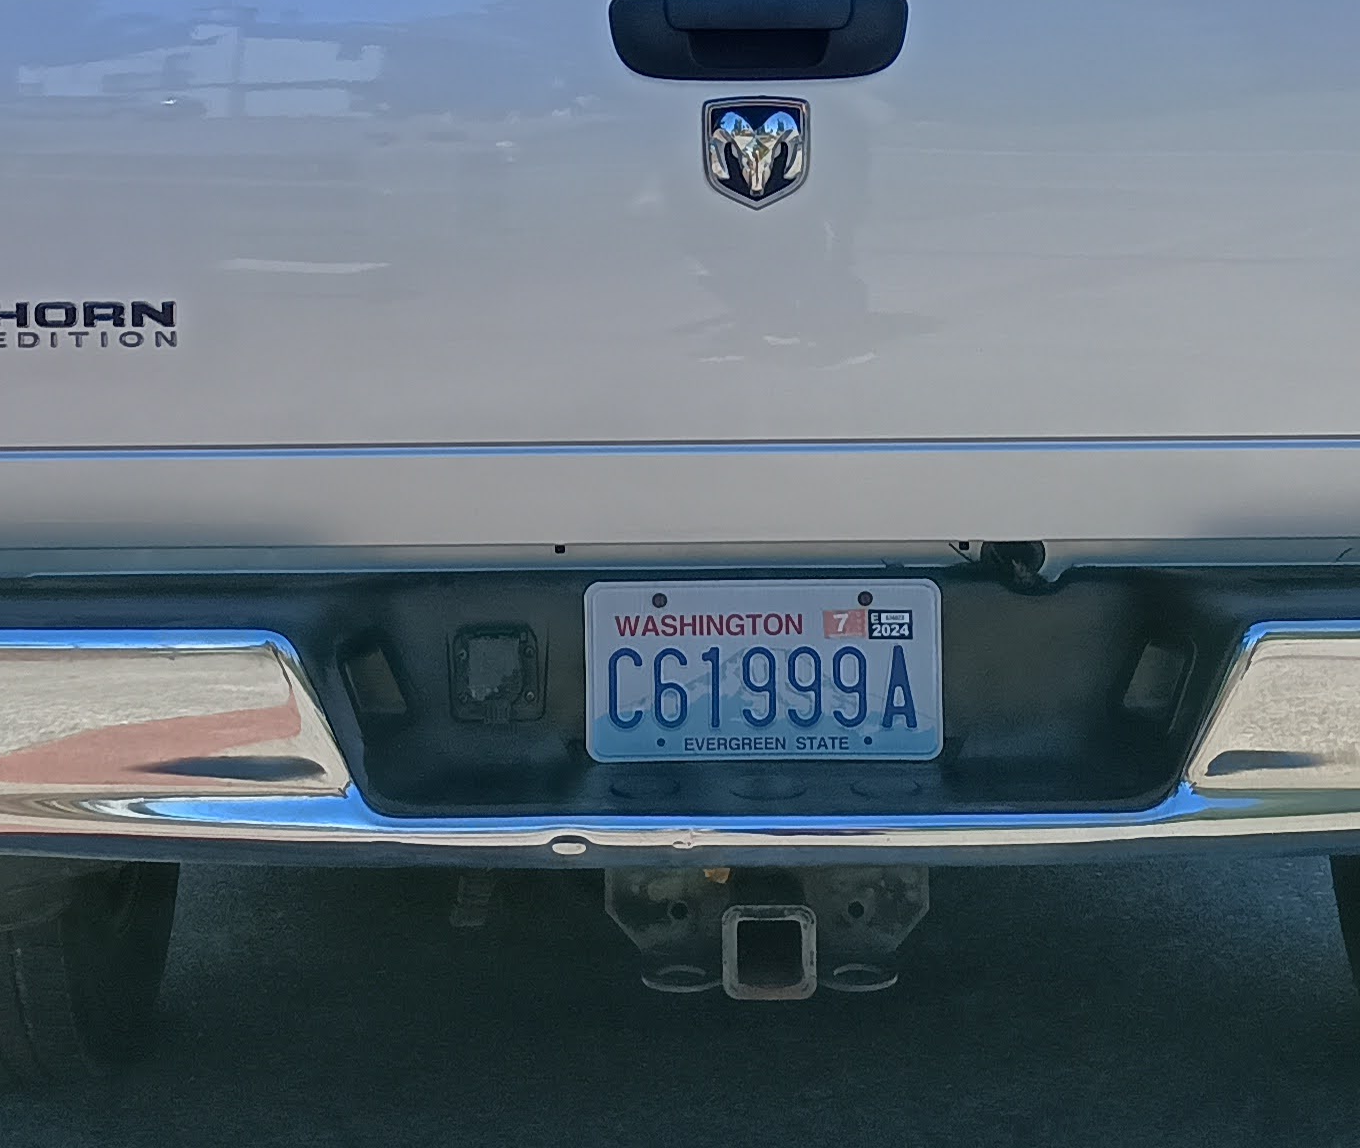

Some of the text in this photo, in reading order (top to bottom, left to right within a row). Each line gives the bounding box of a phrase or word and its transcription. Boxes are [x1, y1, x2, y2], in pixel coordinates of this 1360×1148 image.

[614, 613, 803, 637] WASHINGTON
[833, 613, 849, 632] 7
[870, 613, 879, 624] E
[871, 624, 910, 637] 2024
[608, 645, 918, 729] C61999A
[684, 736, 849, 751] EVERGREEN STATE
